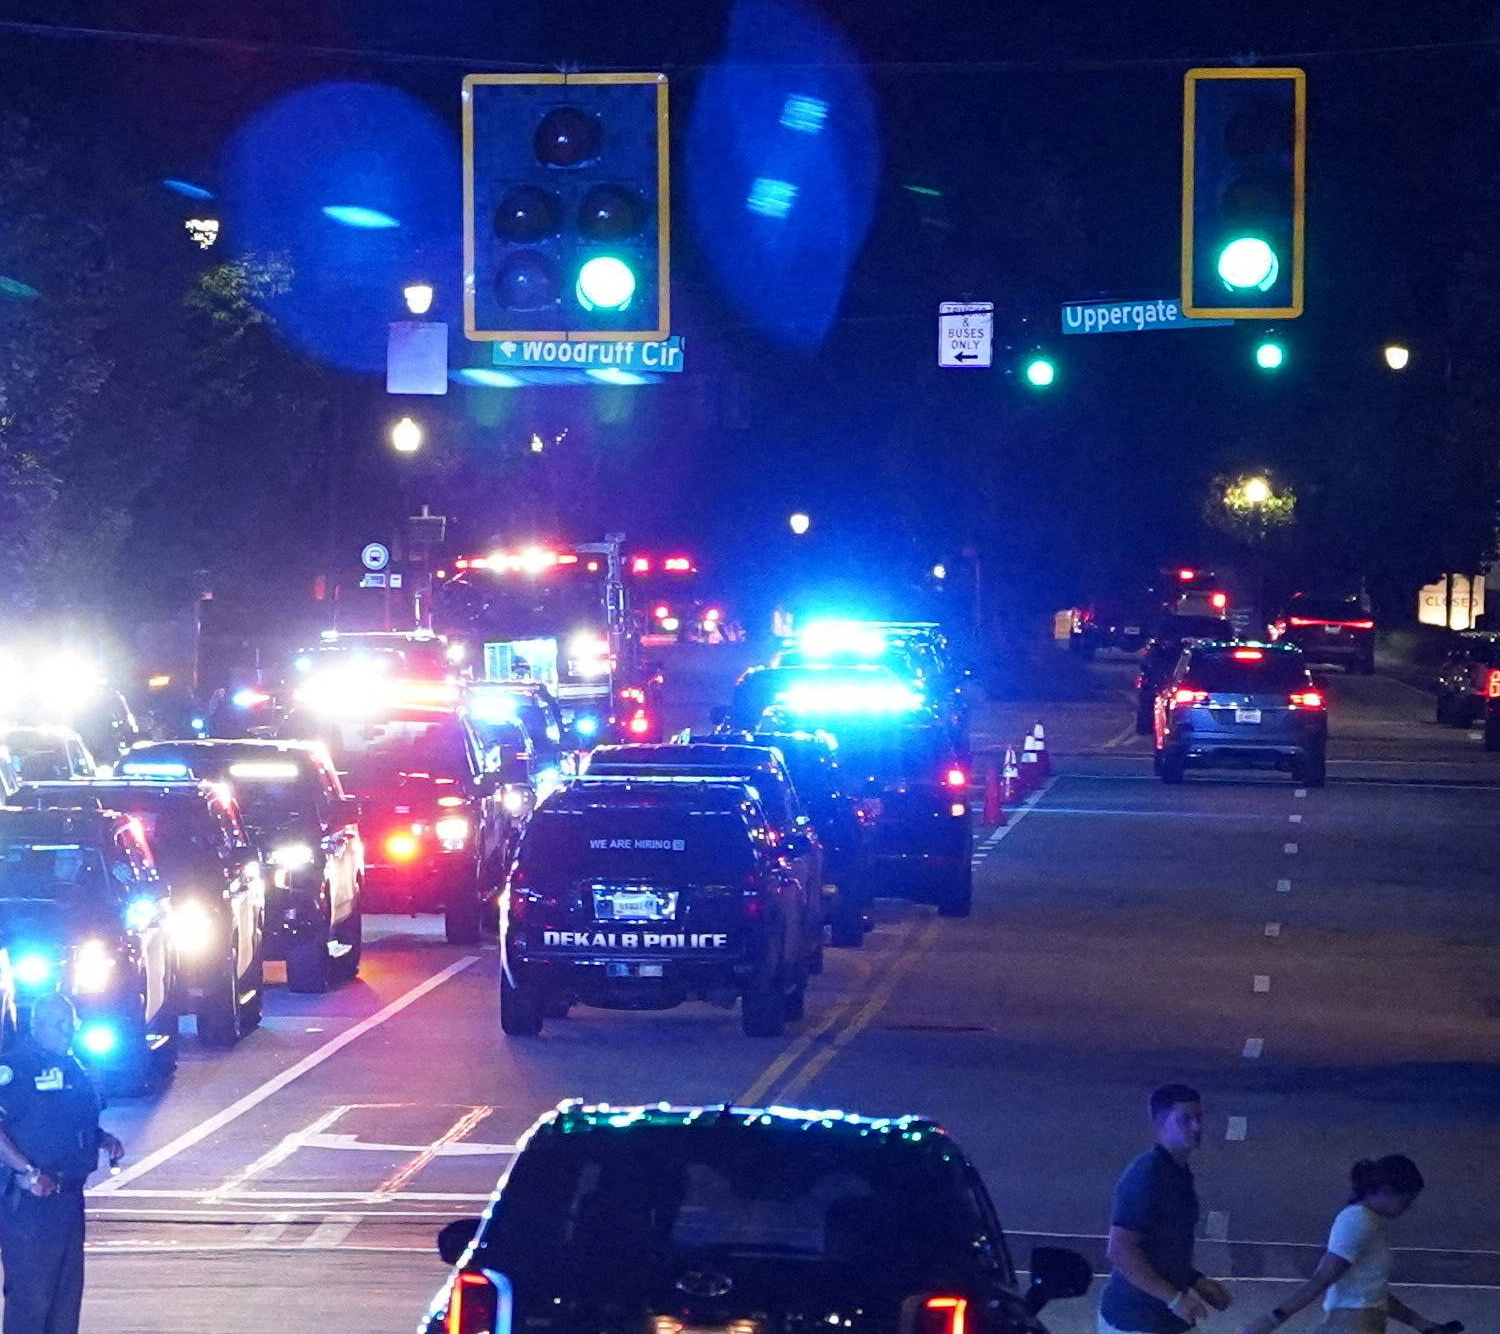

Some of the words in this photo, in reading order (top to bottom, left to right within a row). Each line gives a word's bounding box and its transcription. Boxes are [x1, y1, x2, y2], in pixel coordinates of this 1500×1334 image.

[1066, 300, 1178, 332] Uppergate
[948, 328, 985, 339] BUSES
[522, 340, 635, 365] Woodruff
[641, 341, 681, 366] Cir
[951, 340, 981, 350] ONLY
[643, 932, 728, 949] POLICE
